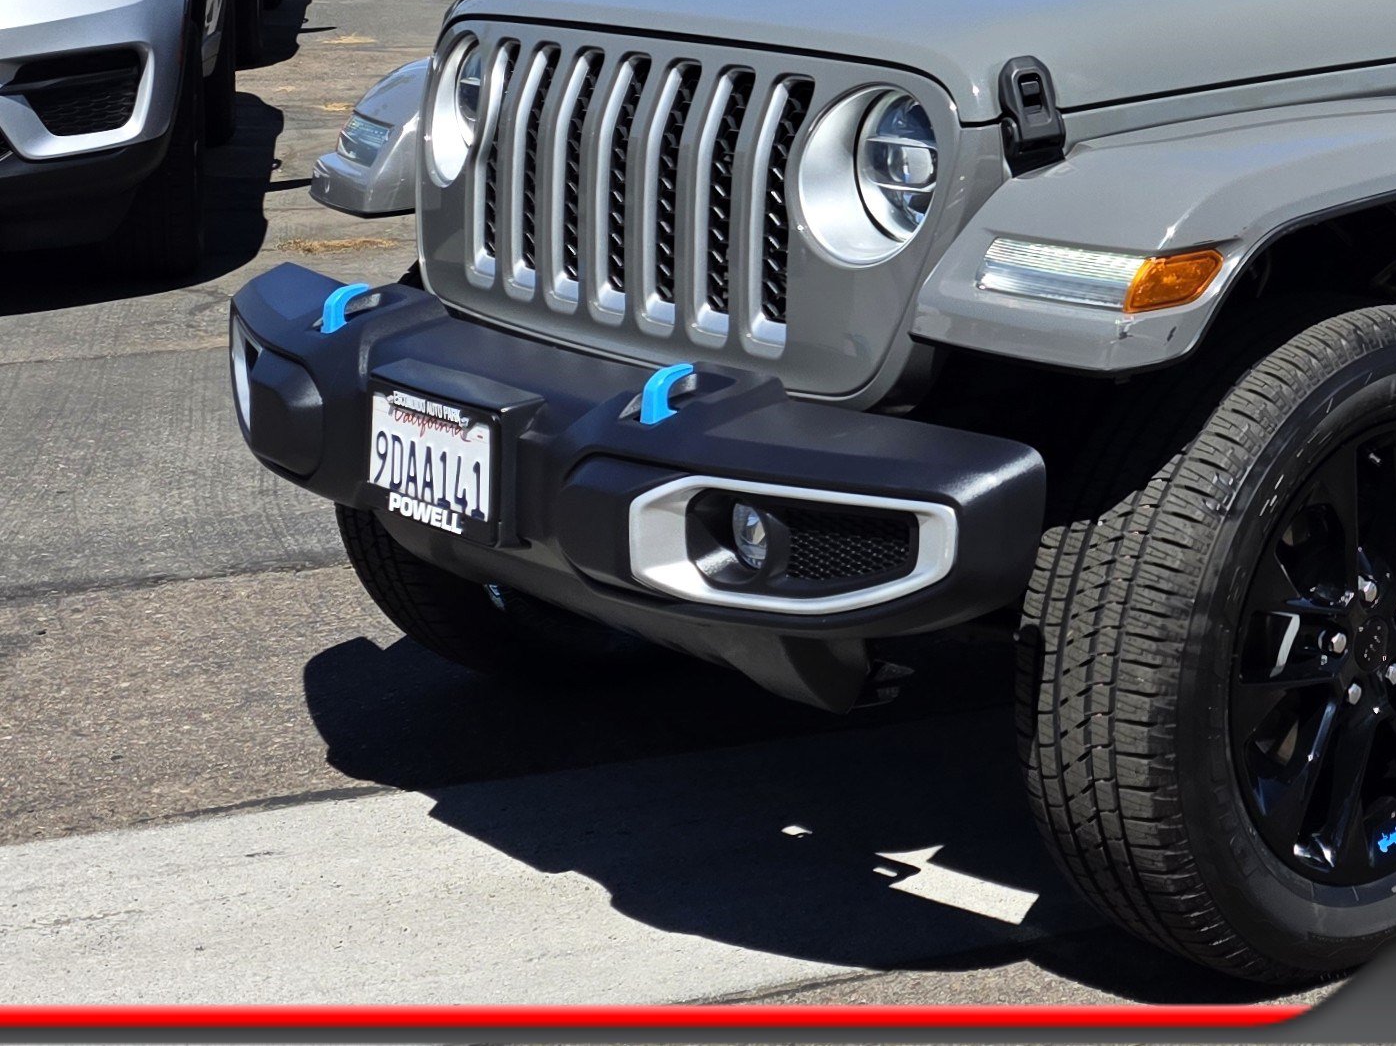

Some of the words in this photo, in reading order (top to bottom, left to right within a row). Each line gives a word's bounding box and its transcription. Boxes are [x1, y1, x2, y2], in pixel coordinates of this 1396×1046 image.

[443, 405, 461, 424] PARK
[373, 430, 485, 521] 9DAA141
[388, 492, 463, 535] POWELL
